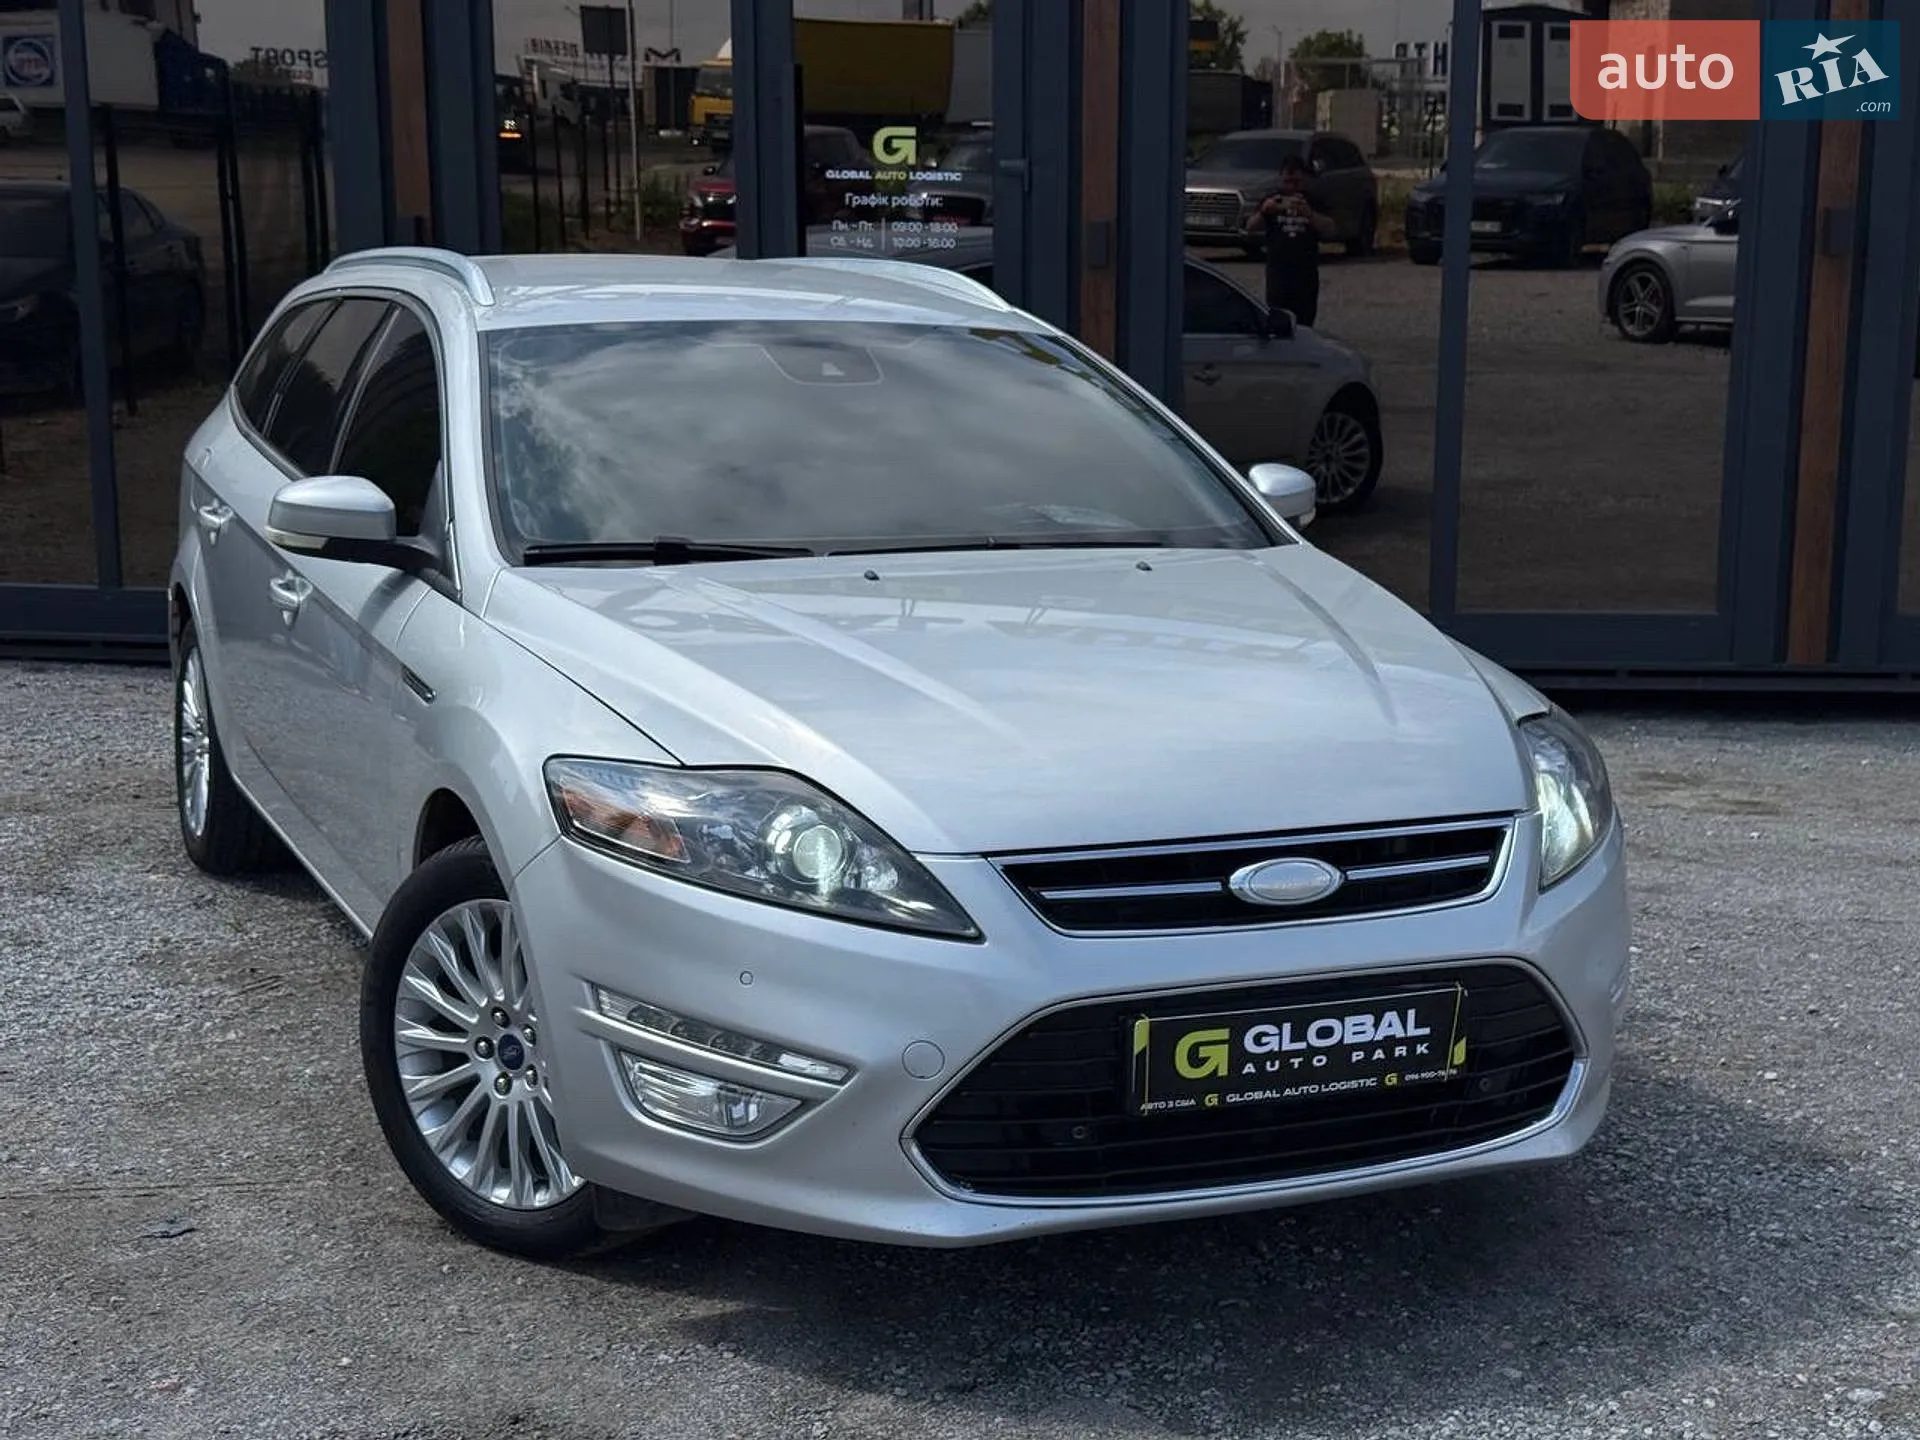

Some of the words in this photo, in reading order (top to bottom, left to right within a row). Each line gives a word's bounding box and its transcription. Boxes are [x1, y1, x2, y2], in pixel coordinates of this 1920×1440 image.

[825, 170, 872, 180] GLOBAL
[875, 171, 907, 181] AUTO
[909, 171, 962, 181] LOGISTIC
[845, 192, 889, 208] Графік
[1243, 1008, 1431, 1054] GLOBAL
[1242, 1055, 1328, 1074] AUTO
[1351, 1042, 1430, 1064] PARK
[1226, 1087, 1281, 1103] GLOBAL
[1283, 1083, 1320, 1096] AUTO
[1321, 1077, 1378, 1092] LOGISTIC
